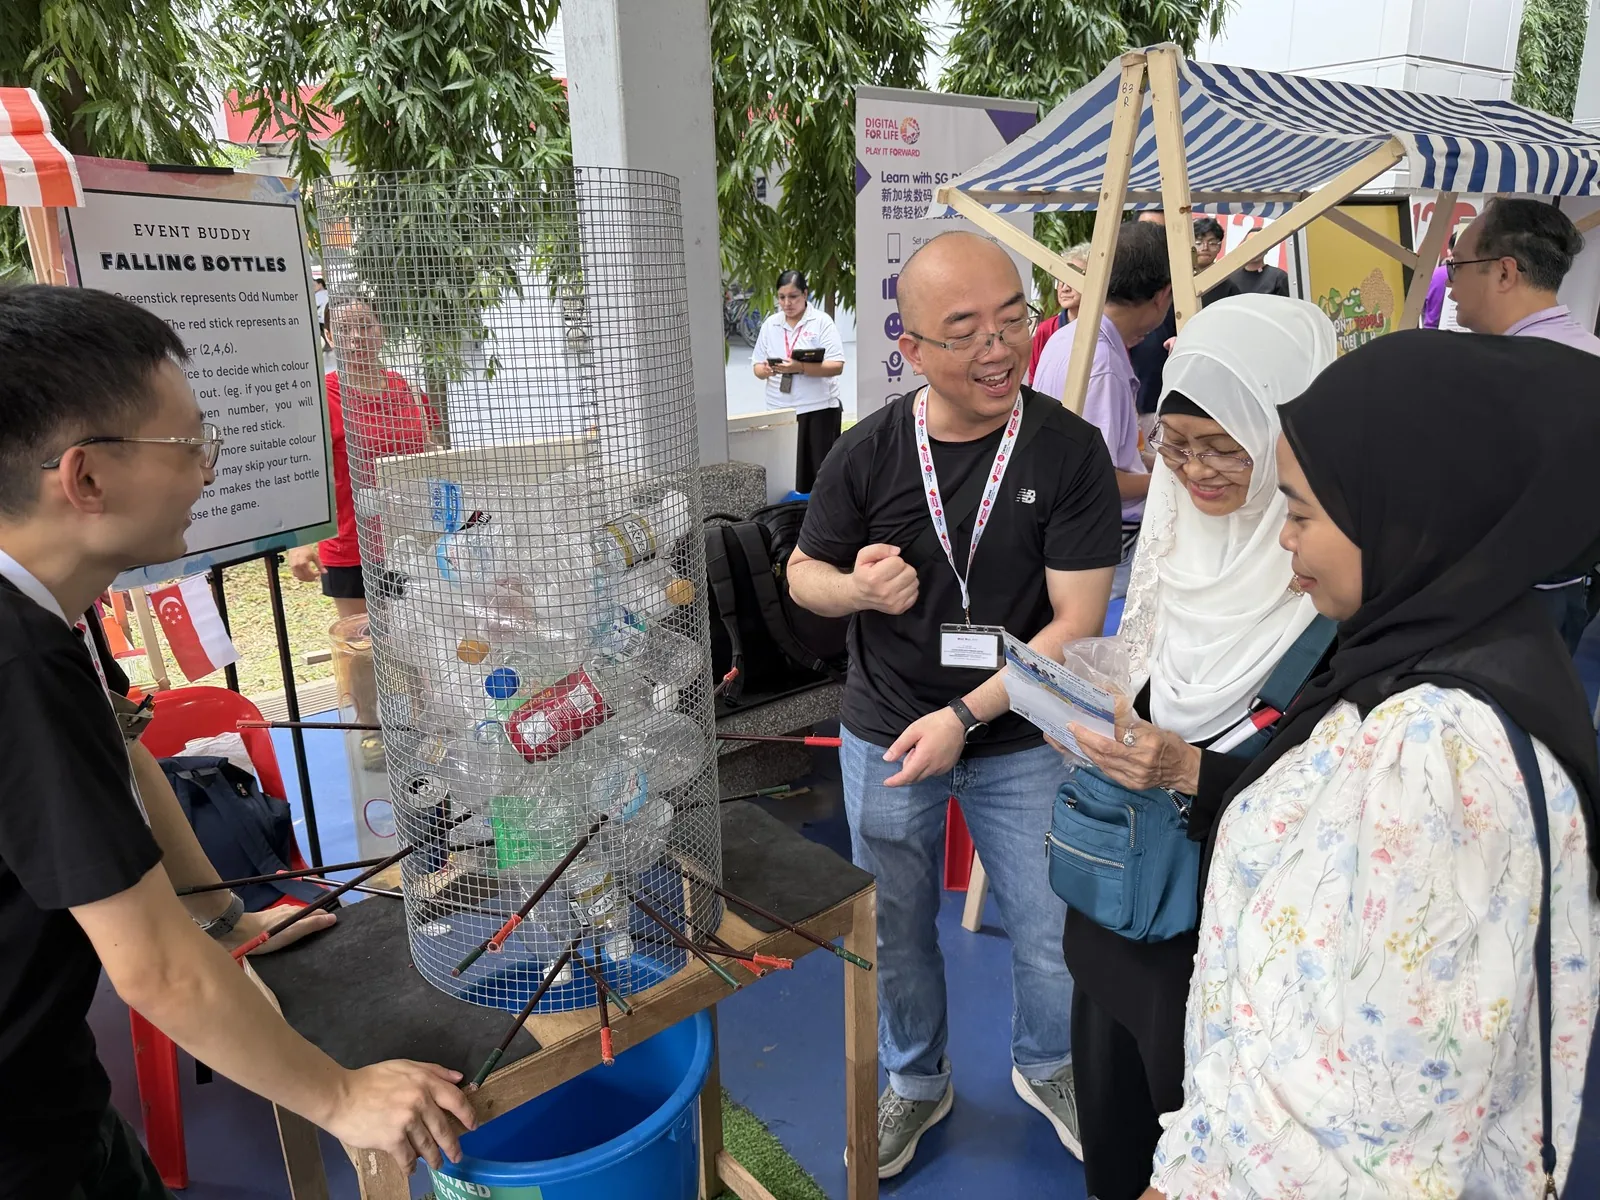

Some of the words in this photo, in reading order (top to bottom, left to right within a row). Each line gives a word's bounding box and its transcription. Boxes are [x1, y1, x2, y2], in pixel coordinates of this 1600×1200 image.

[866, 118, 898, 130] DIGITAL
[866, 130, 881, 139] FOR
[884, 130, 898, 140] LIFE
[866, 147, 881, 155] PLAY
[890, 148, 920, 157] FORWARD
[881, 171, 909, 183] Learn
[912, 172, 932, 184] with
[934, 172, 948, 184] SG
[882, 188, 932, 202] 新加坡数码
[134, 224, 190, 238] EVENT
[198, 226, 251, 241] BUDDY
[100, 252, 197, 271] FALLING
[201, 255, 287, 272] BOTTLES
[181, 292, 237, 305] represents
[238, 292, 260, 302] Odd
[262, 291, 299, 302] Number
[188, 318, 206, 330] red
[209, 317, 234, 329] stick
[236, 317, 286, 330] represents
[288, 316, 299, 325] an
[200, 342, 238, 356] (2,4,6).
[184, 368, 200, 379] ice
[202, 368, 213, 378] to
[216, 365, 249, 376] decide
[251, 362, 279, 374] which
[281, 360, 309, 371] colour
[200, 388, 220, 399] out.
[224, 385, 242, 398] (eg.
[245, 383, 252, 394] if
[254, 383, 272, 396] you
[275, 381, 289, 393] get
[292, 380, 298, 388] 4
[300, 380, 311, 388] on
[202, 409, 220, 418] ven
[228, 404, 269, 416] number,
[275, 400, 292, 411] you
[298, 396, 313, 407] will
[223, 425, 239, 436] the
[242, 423, 258, 434] red
[260, 419, 285, 431] stick.
[221, 444, 246, 456] more
[250, 437, 286, 451] suitable
[288, 434, 316, 446] colour
[222, 464, 242, 476] may
[245, 460, 264, 472] skip
[267, 457, 288, 469] your
[290, 452, 311, 463] turn.
[220, 482, 252, 496] makes
[255, 478, 271, 489] the
[274, 475, 290, 486] last
[294, 469, 320, 481] bottle
[190, 510, 208, 520] ose
[211, 506, 228, 517] the
[231, 500, 260, 515] game.
